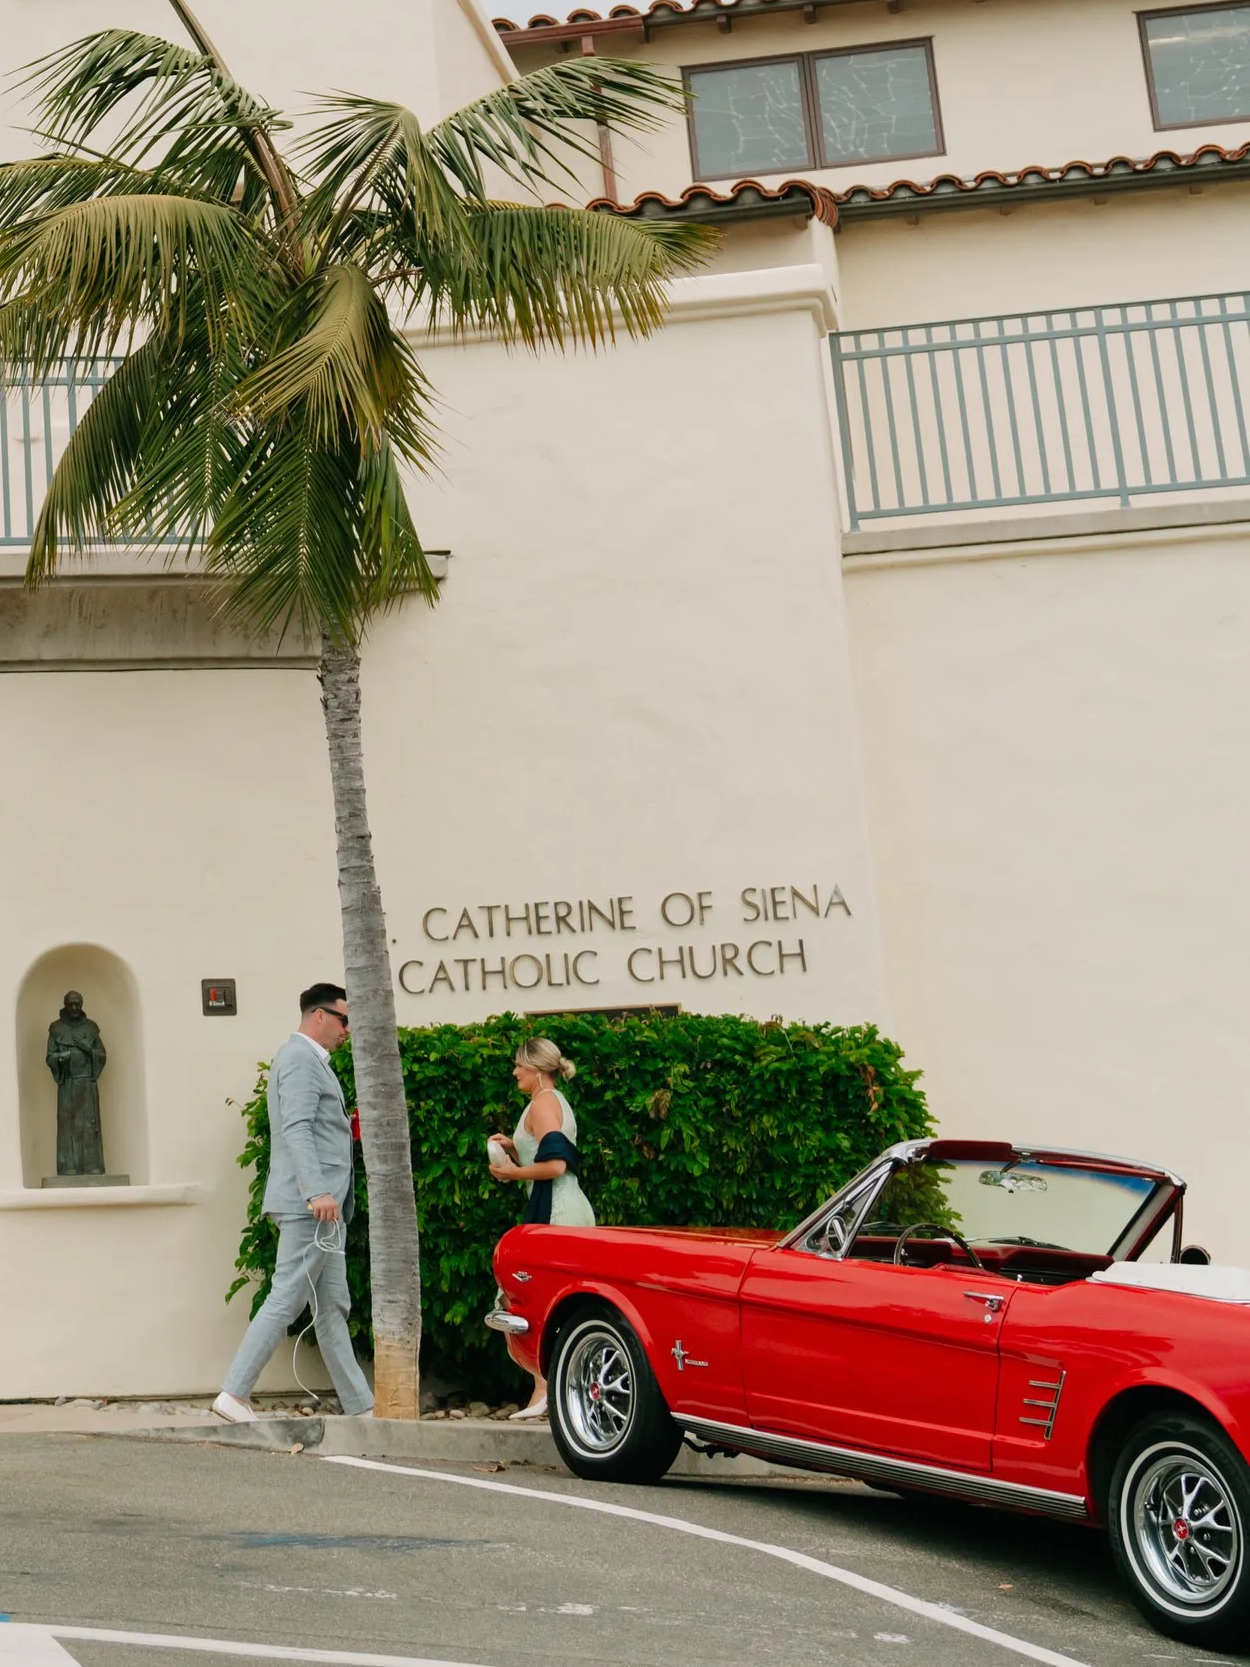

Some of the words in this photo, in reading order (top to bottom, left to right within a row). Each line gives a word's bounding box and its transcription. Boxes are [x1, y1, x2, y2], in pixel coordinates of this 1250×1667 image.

[422, 896, 636, 942] CATHERINE
[660, 891, 713, 927] OF
[741, 883, 852, 923] SIENA
[398, 949, 600, 995] CATHOLIC
[627, 938, 807, 983] CHURCH
